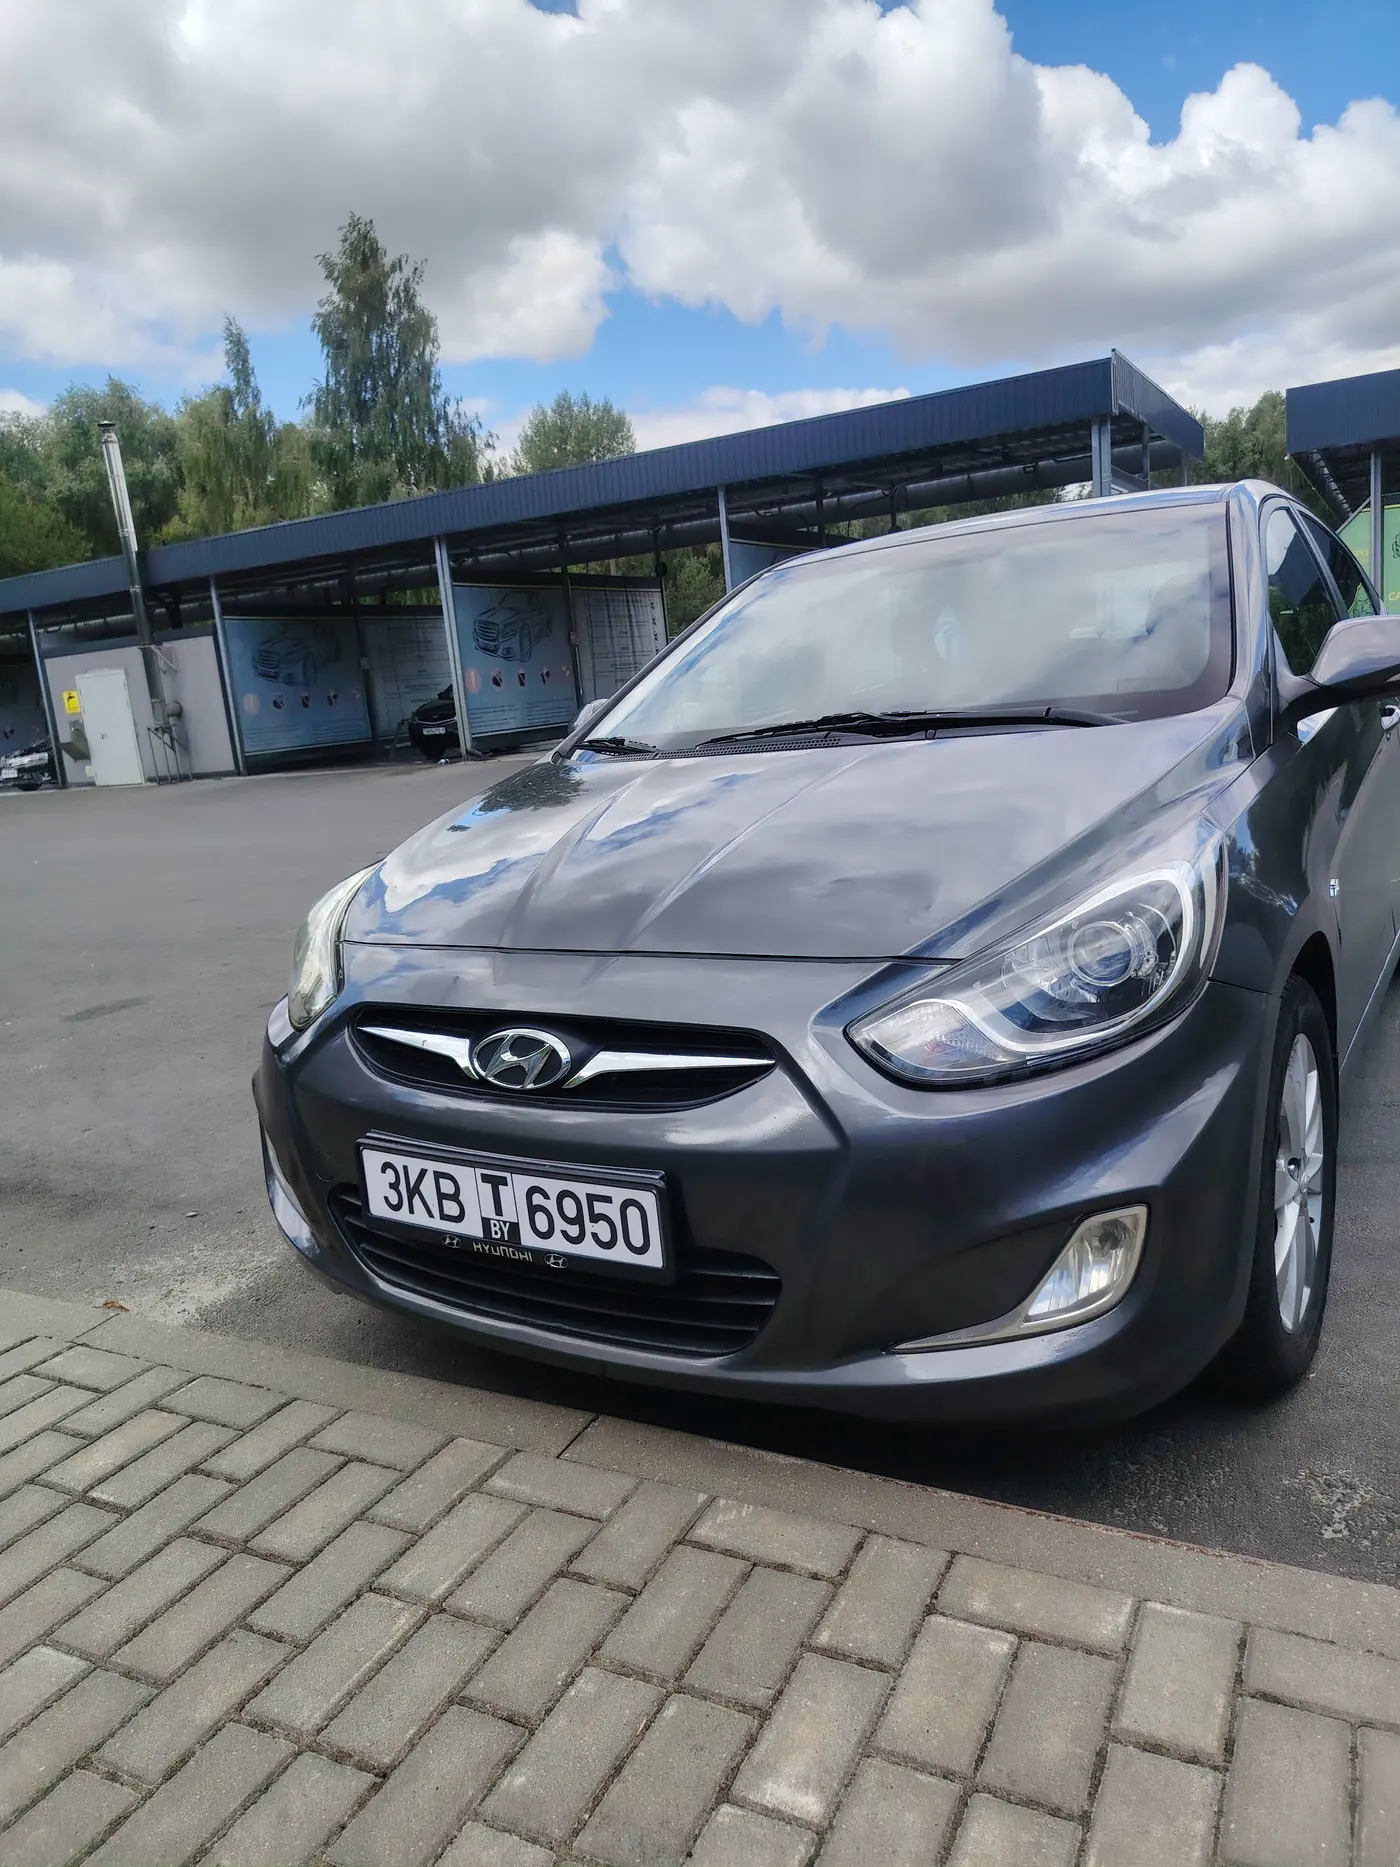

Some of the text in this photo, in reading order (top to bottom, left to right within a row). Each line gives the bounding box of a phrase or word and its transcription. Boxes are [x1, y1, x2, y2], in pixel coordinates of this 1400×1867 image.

[380, 1161, 652, 1256] 3KB T 6950
[490, 1219, 512, 1241] BY
